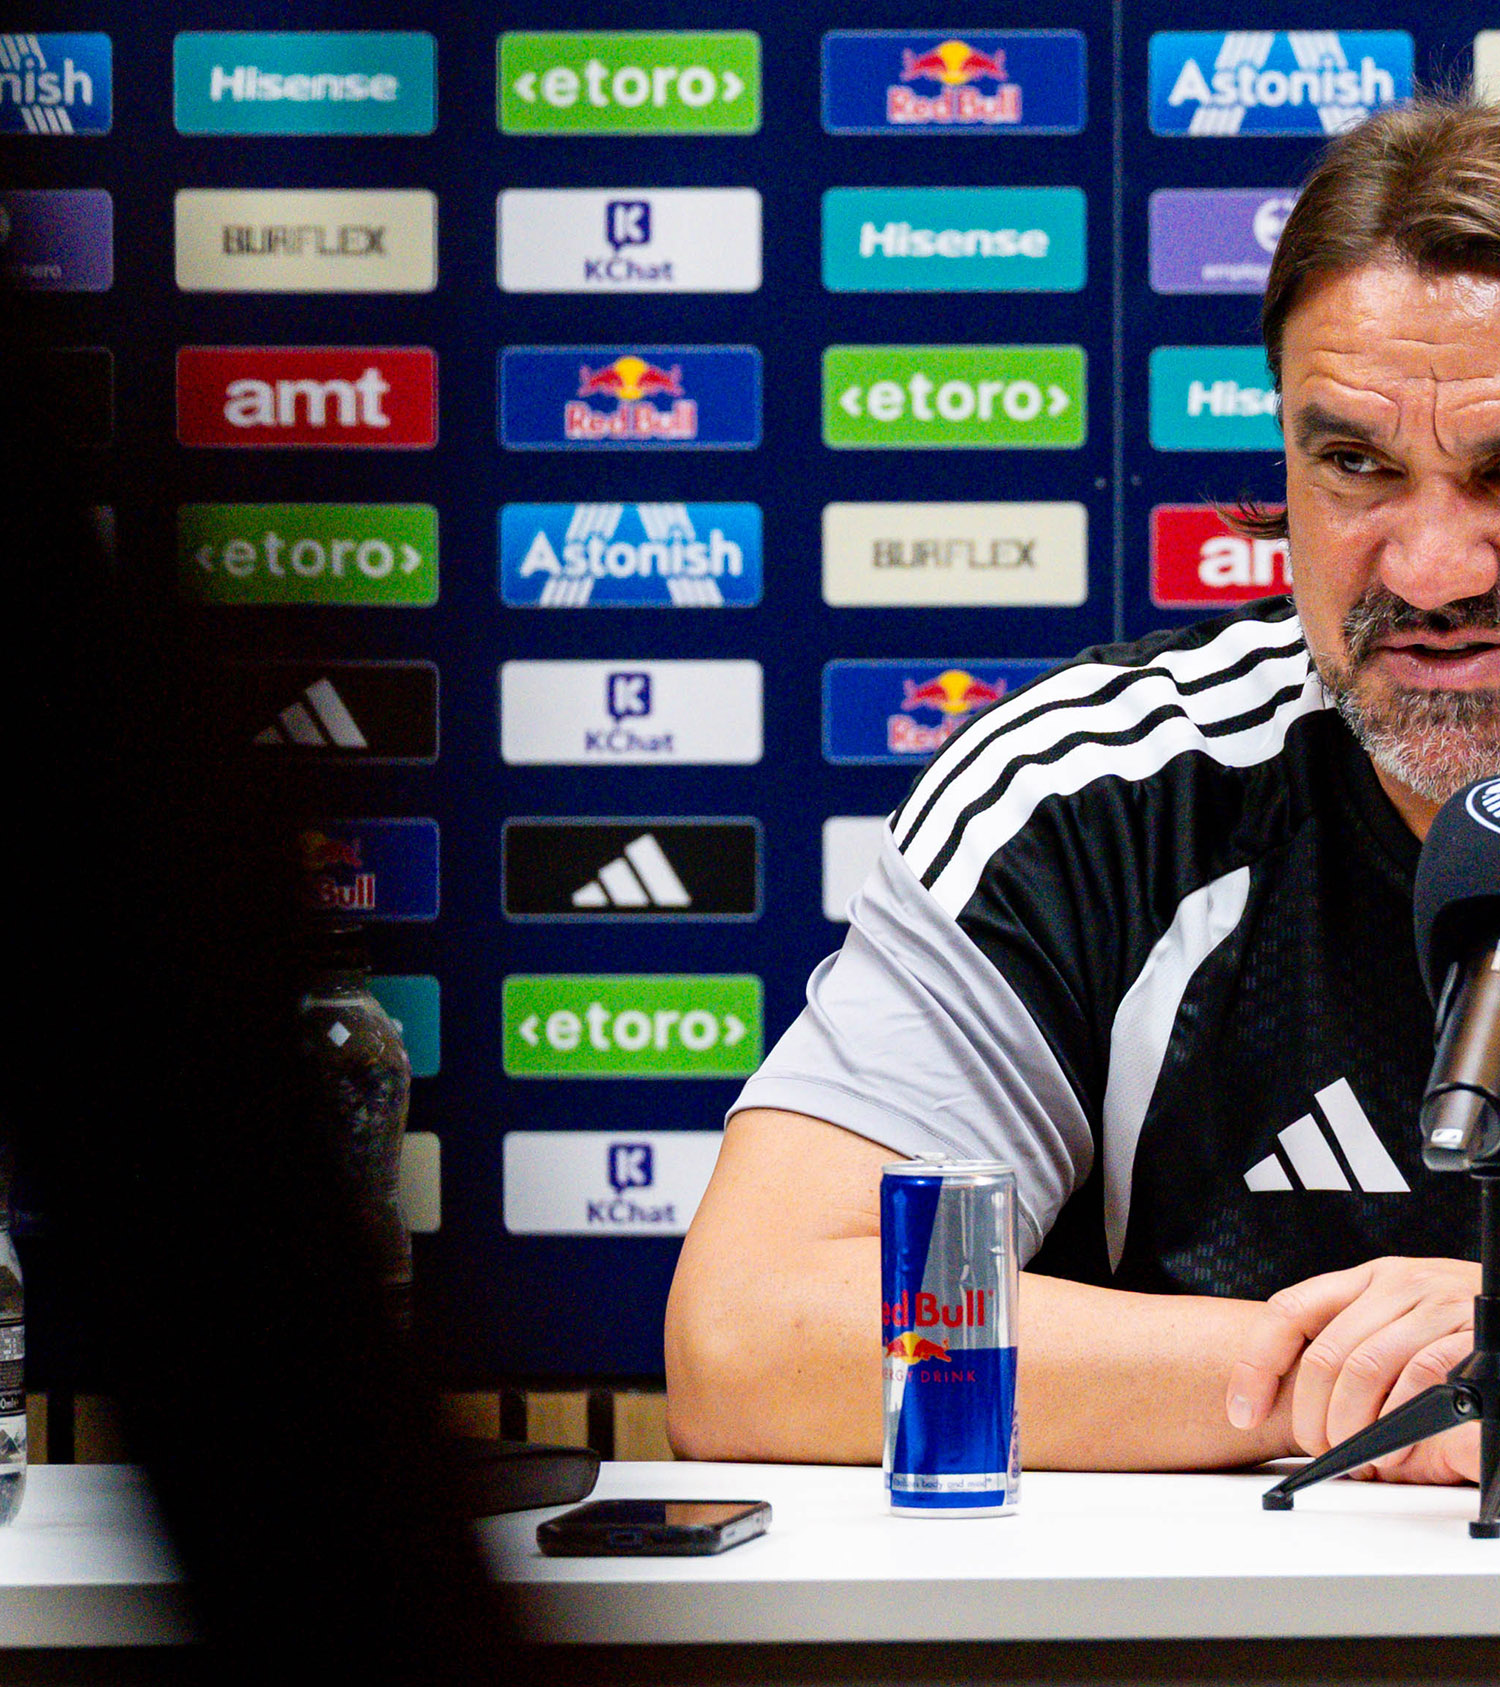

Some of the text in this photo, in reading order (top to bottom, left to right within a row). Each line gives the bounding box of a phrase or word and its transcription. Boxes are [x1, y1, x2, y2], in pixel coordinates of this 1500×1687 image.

[210, 66, 397, 101] Hisense
[1170, 56, 1394, 106] Astonish
[888, 85, 953, 123] Red
[222, 225, 386, 257] BURFLEX
[860, 222, 1049, 257] Hisense
[584, 258, 672, 281] KChat
[225, 368, 390, 427] amt
[565, 401, 628, 439] Red
[520, 530, 743, 579] Astonish
[872, 540, 1035, 569] BURFLEX
[585, 730, 673, 753] KChat
[586, 1201, 674, 1224] KChat
[915, 1289, 986, 1328] Bull
[921, 1370, 976, 1383] DRINK
